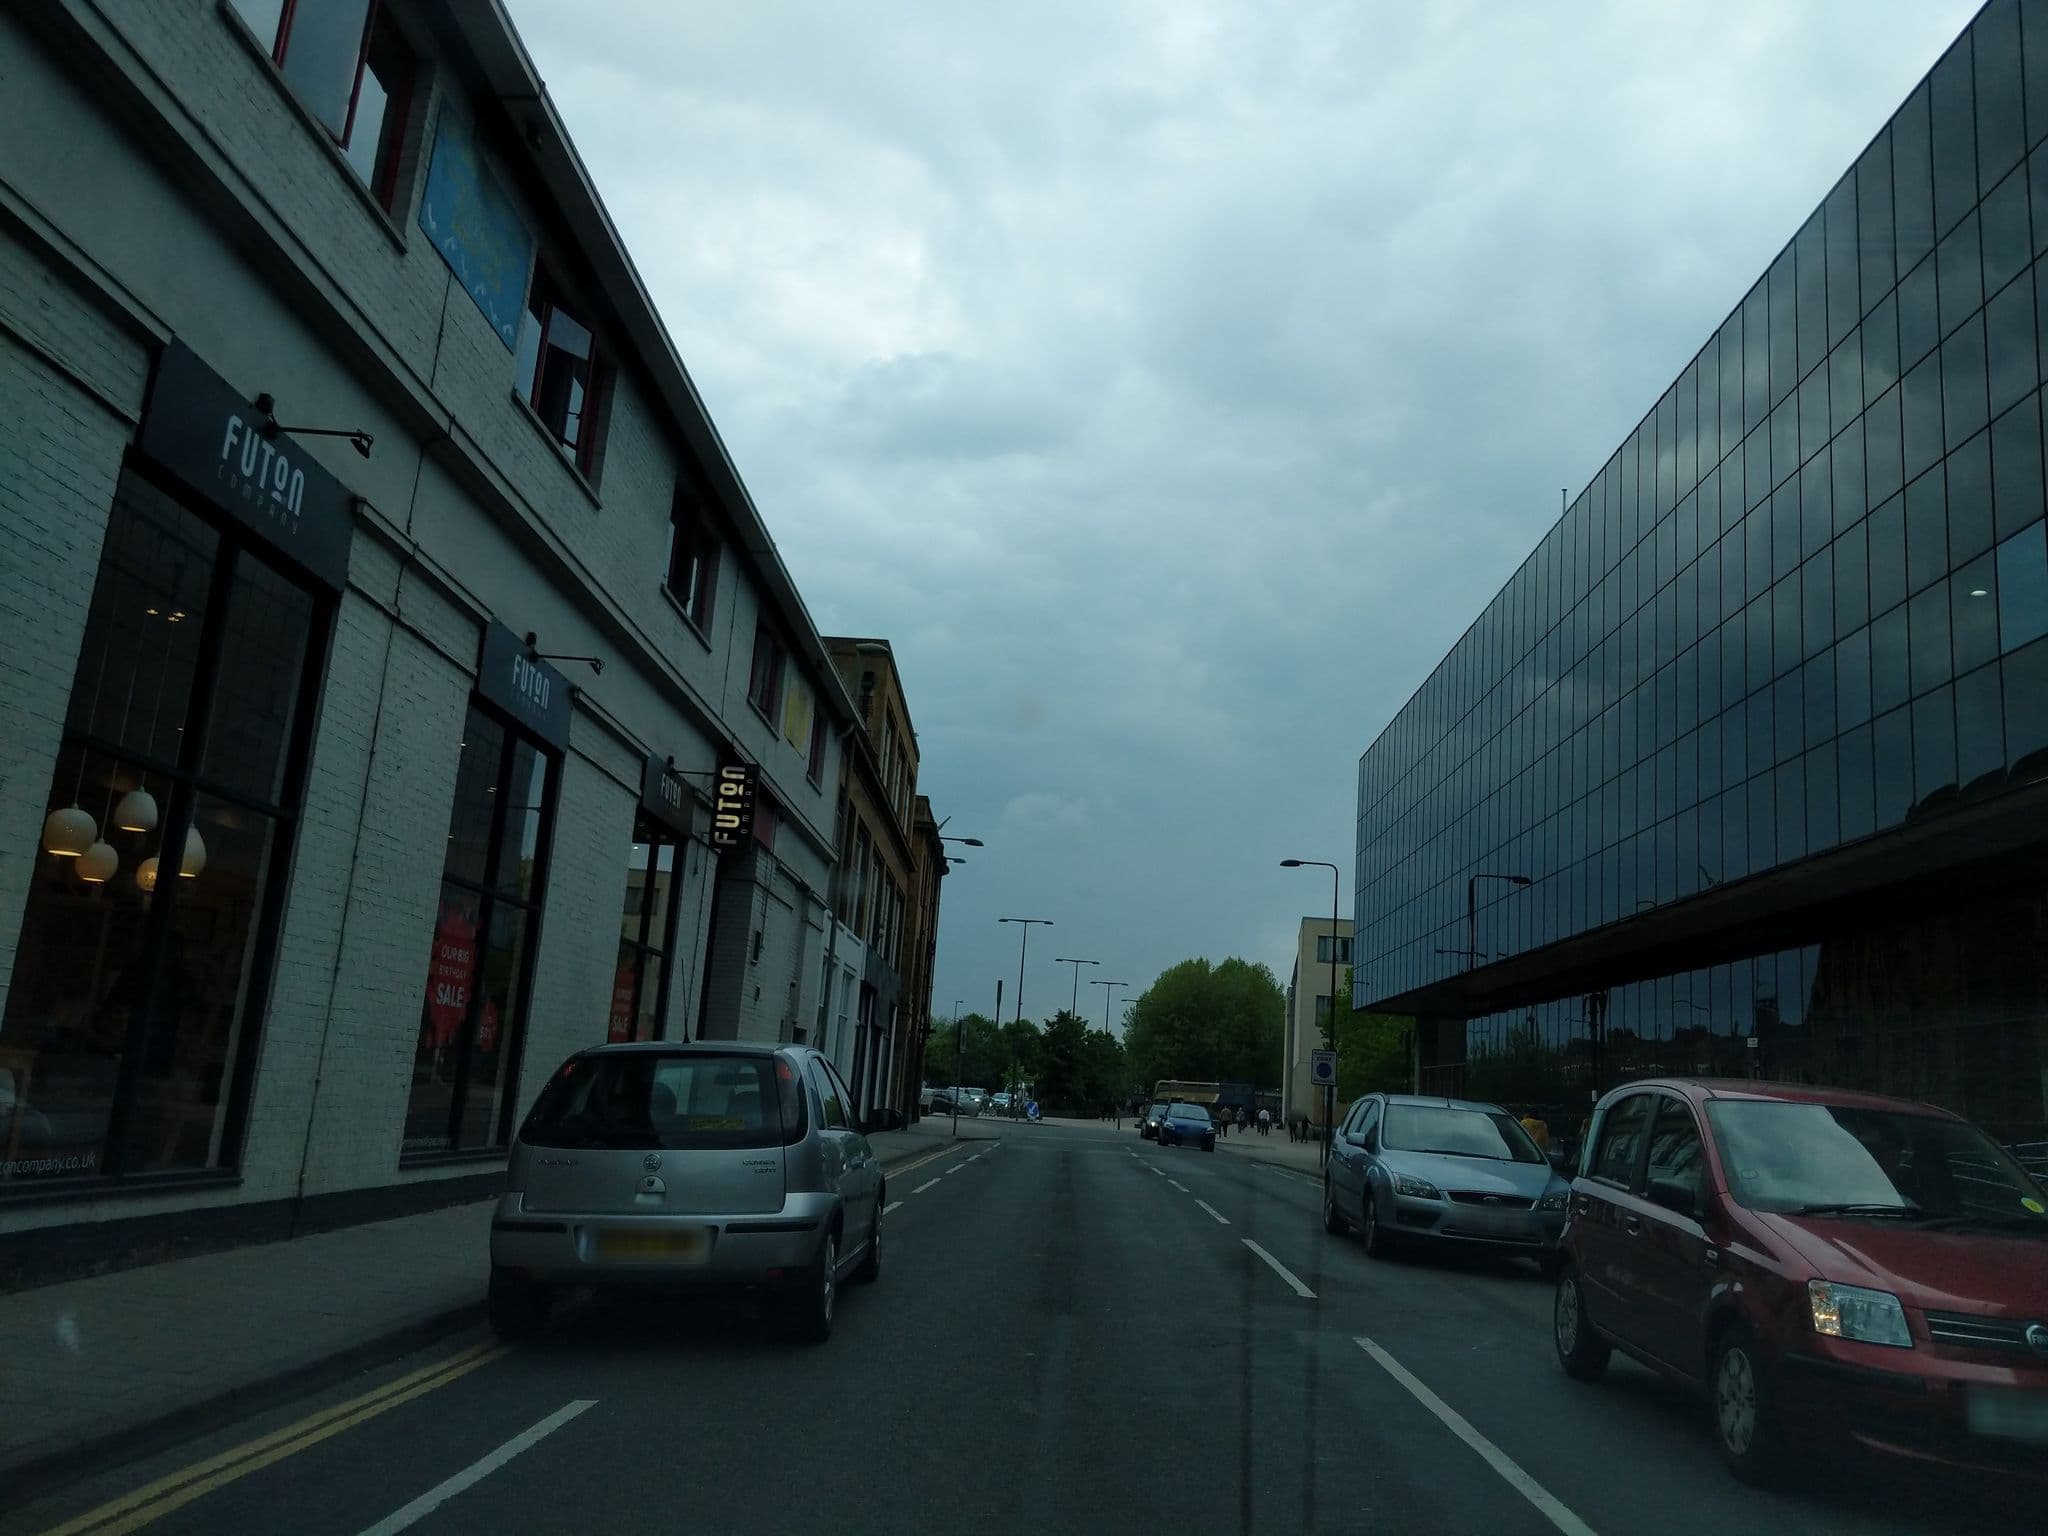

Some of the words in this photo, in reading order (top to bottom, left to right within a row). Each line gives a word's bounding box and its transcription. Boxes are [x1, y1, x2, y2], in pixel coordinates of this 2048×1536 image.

[222, 414, 305, 517] FUTON
[513, 653, 550, 710] FUTON
[713, 765, 746, 845] FUTON
[441, 944, 457, 960] OUR
[436, 983, 465, 1009] SALE
